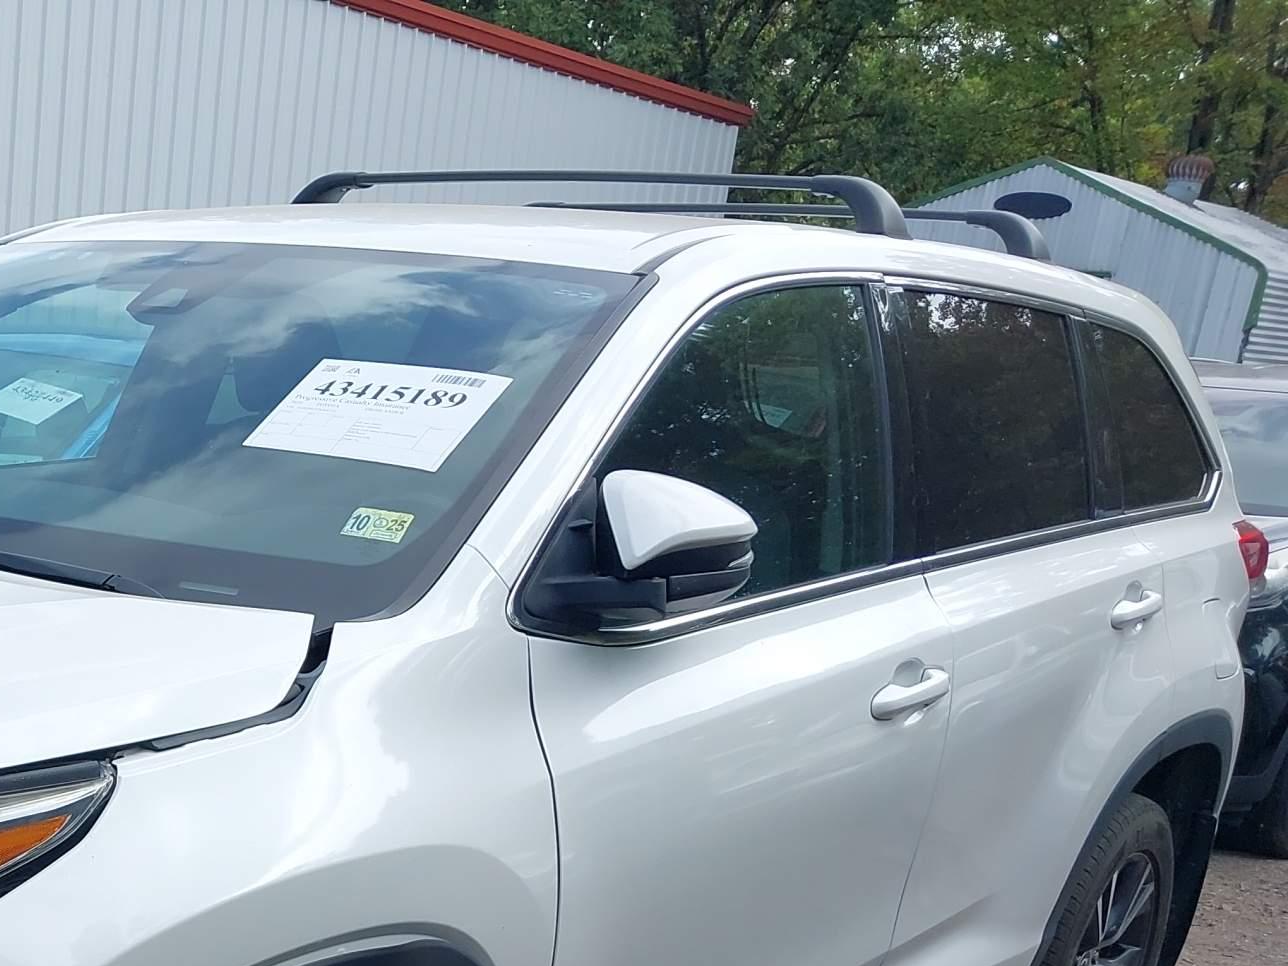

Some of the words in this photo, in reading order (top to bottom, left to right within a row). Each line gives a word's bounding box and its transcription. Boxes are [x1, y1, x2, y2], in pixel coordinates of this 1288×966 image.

[314, 380, 467, 408] 43415189
[350, 513, 371, 531] 10
[385, 518, 408, 532] 25
